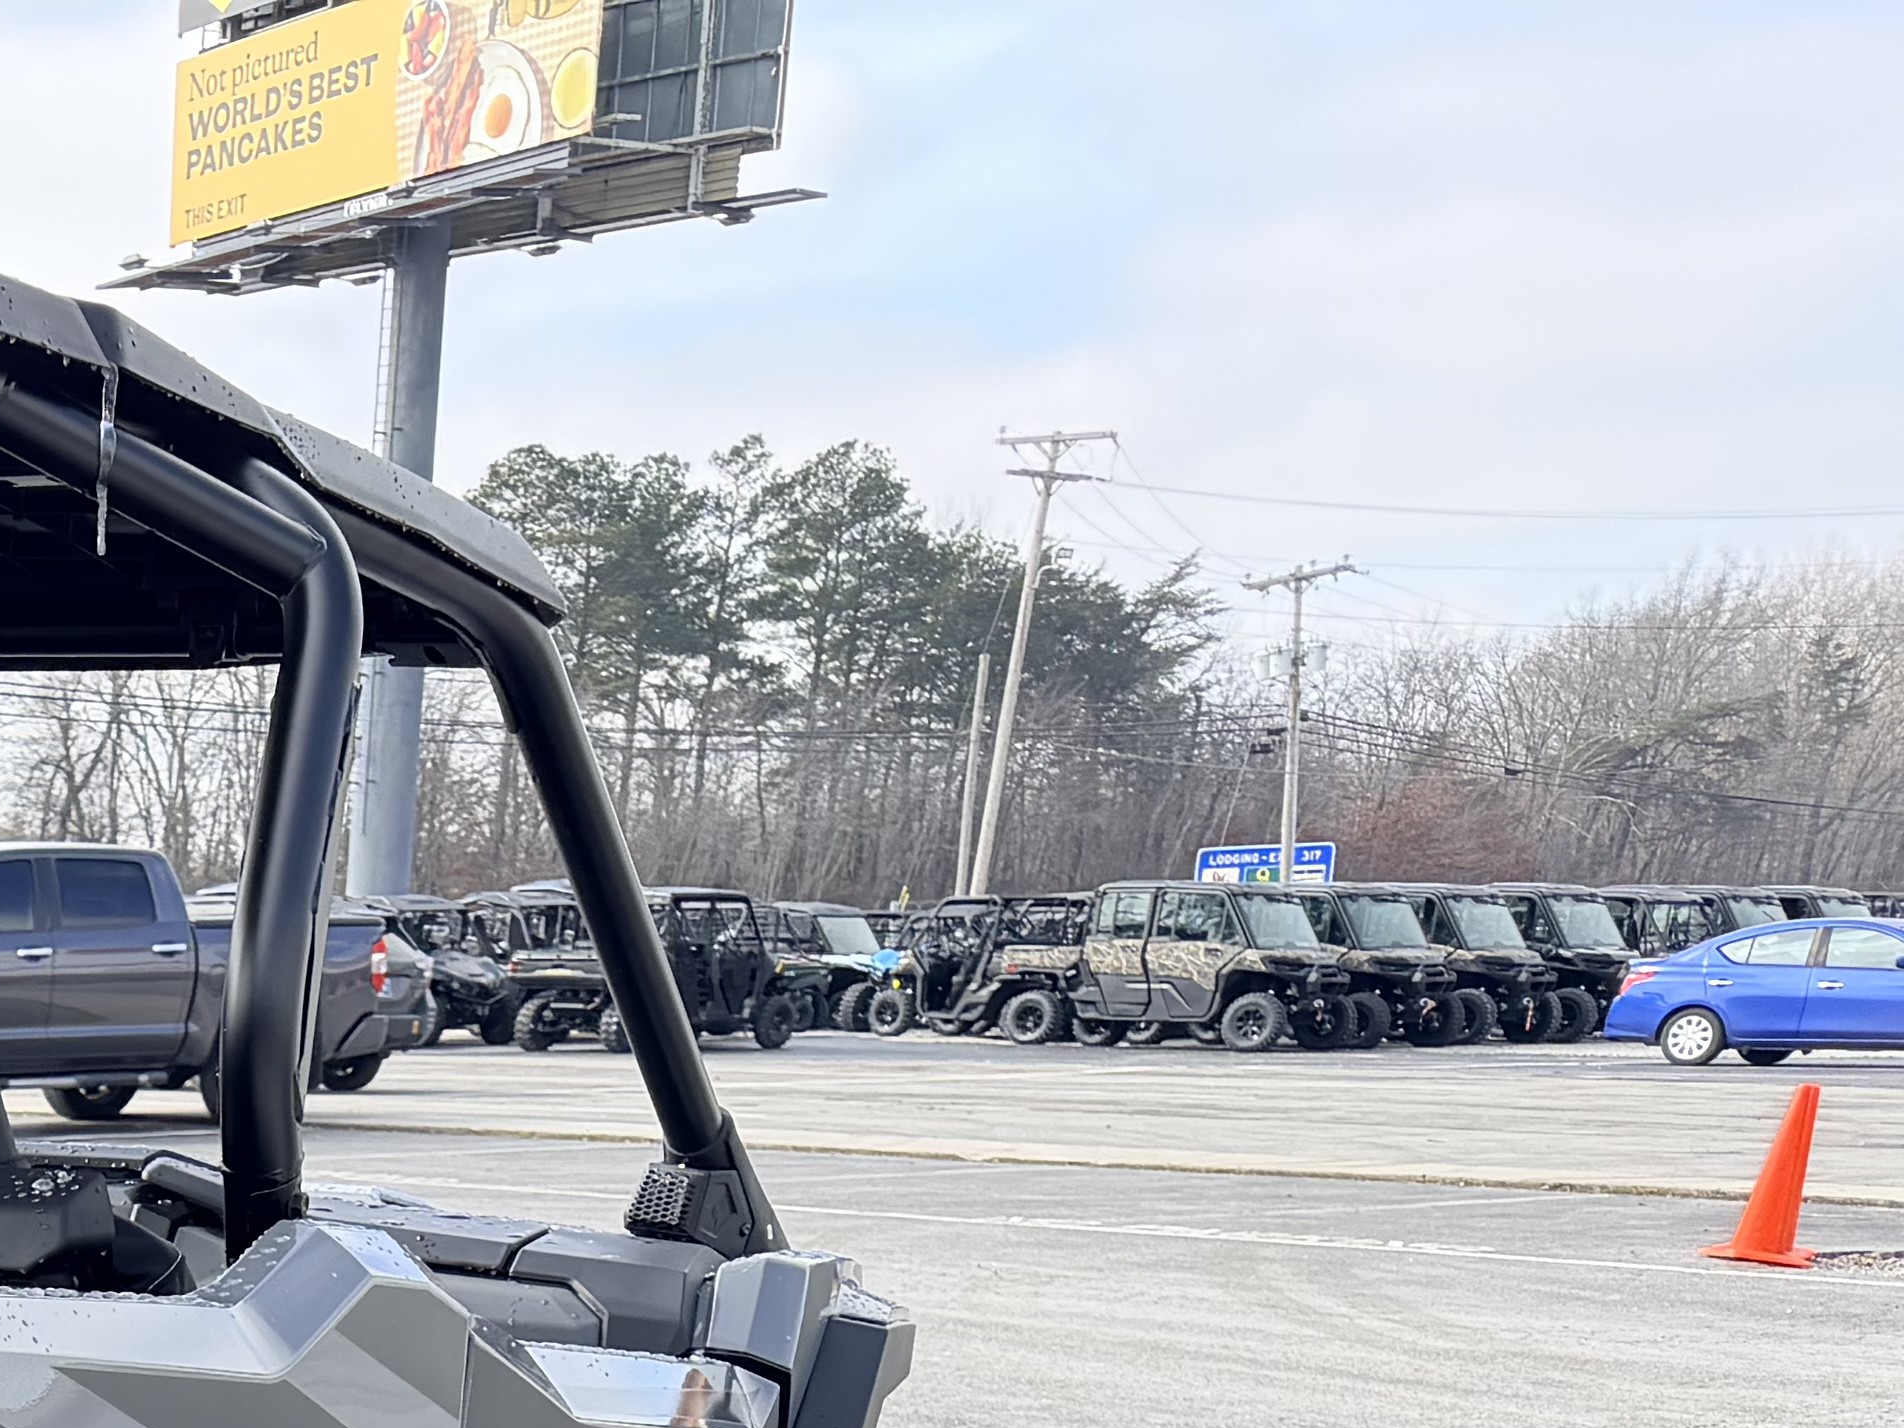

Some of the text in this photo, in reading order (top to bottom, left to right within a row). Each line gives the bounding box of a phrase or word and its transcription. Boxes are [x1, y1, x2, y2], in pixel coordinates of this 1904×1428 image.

[188, 31, 319, 102] Not pictured
[188, 53, 379, 141] WORLD'S BEST
[186, 111, 322, 180] PANCAKES
[185, 194, 247, 228] THIS EXIT
[1208, 853, 1259, 866] LODGING
